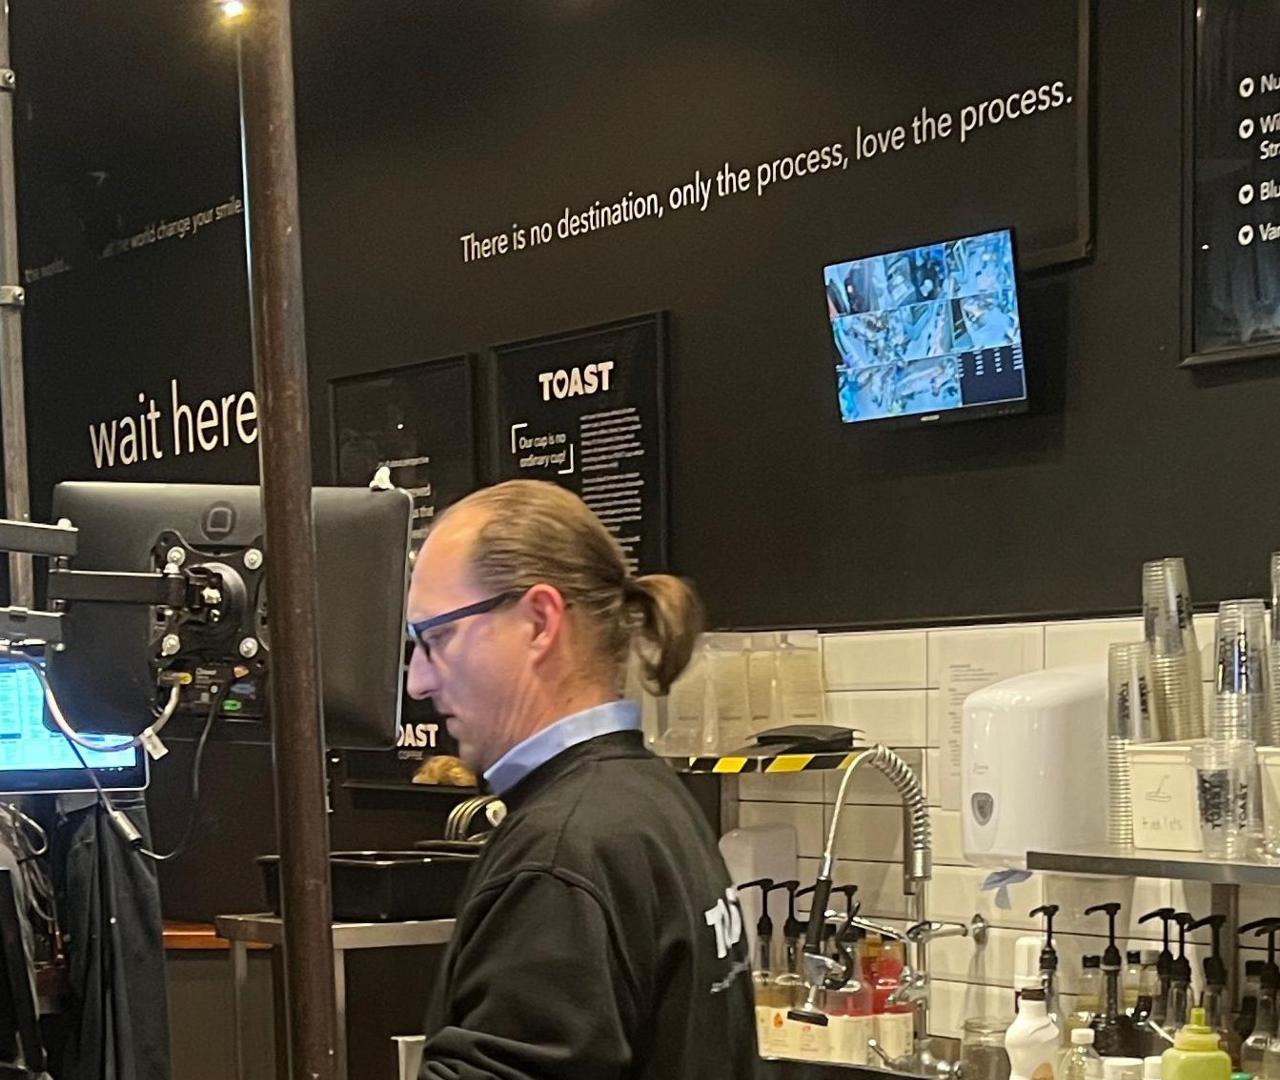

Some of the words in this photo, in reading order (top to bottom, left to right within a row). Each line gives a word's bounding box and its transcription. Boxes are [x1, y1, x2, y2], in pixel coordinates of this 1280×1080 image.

[460, 232, 508, 262] There
[512, 223, 526, 251] is
[530, 222, 552, 247] no
[557, 191, 665, 239] destination,
[669, 170, 712, 212] only
[716, 162, 751, 198] the
[757, 143, 849, 196] process,
[856, 126, 905, 160] love
[912, 106, 952, 145] the
[960, 81, 1073, 143] process.
[88, 391, 164, 468] wait
[172, 378, 258, 455] here
[538, 361, 614, 401] TOAST
